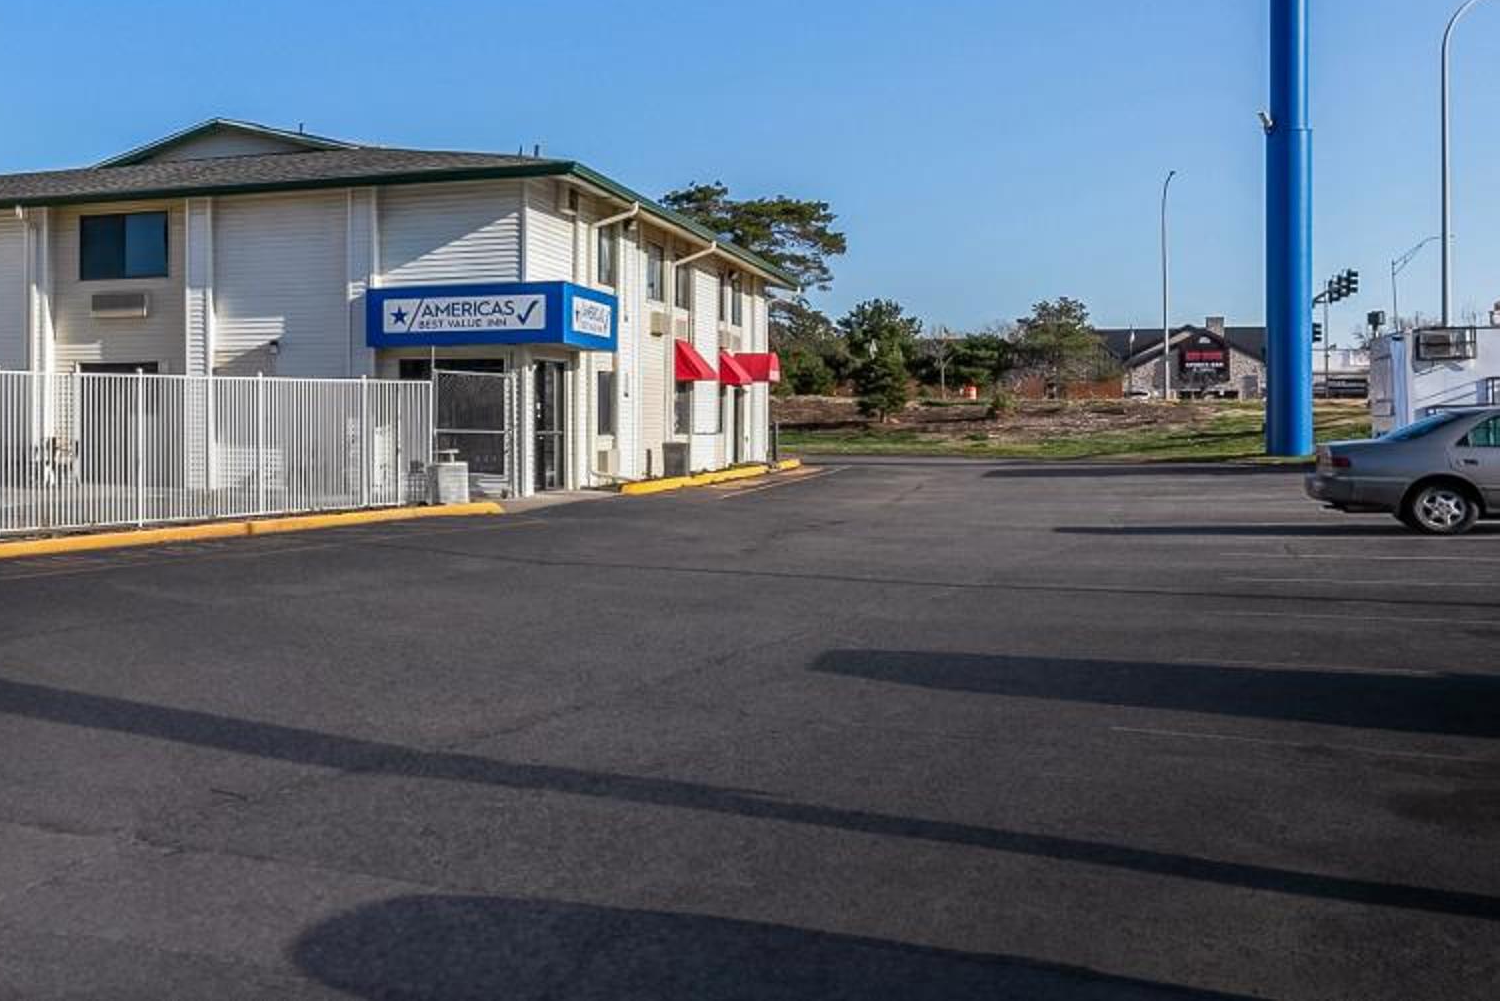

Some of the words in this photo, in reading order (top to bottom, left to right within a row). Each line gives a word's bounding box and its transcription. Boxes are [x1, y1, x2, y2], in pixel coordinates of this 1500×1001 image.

[421, 300, 515, 318] AMERICAS
[418, 319, 443, 330] BEST
[448, 318, 482, 328] VALUE
[487, 317, 507, 327] INN
